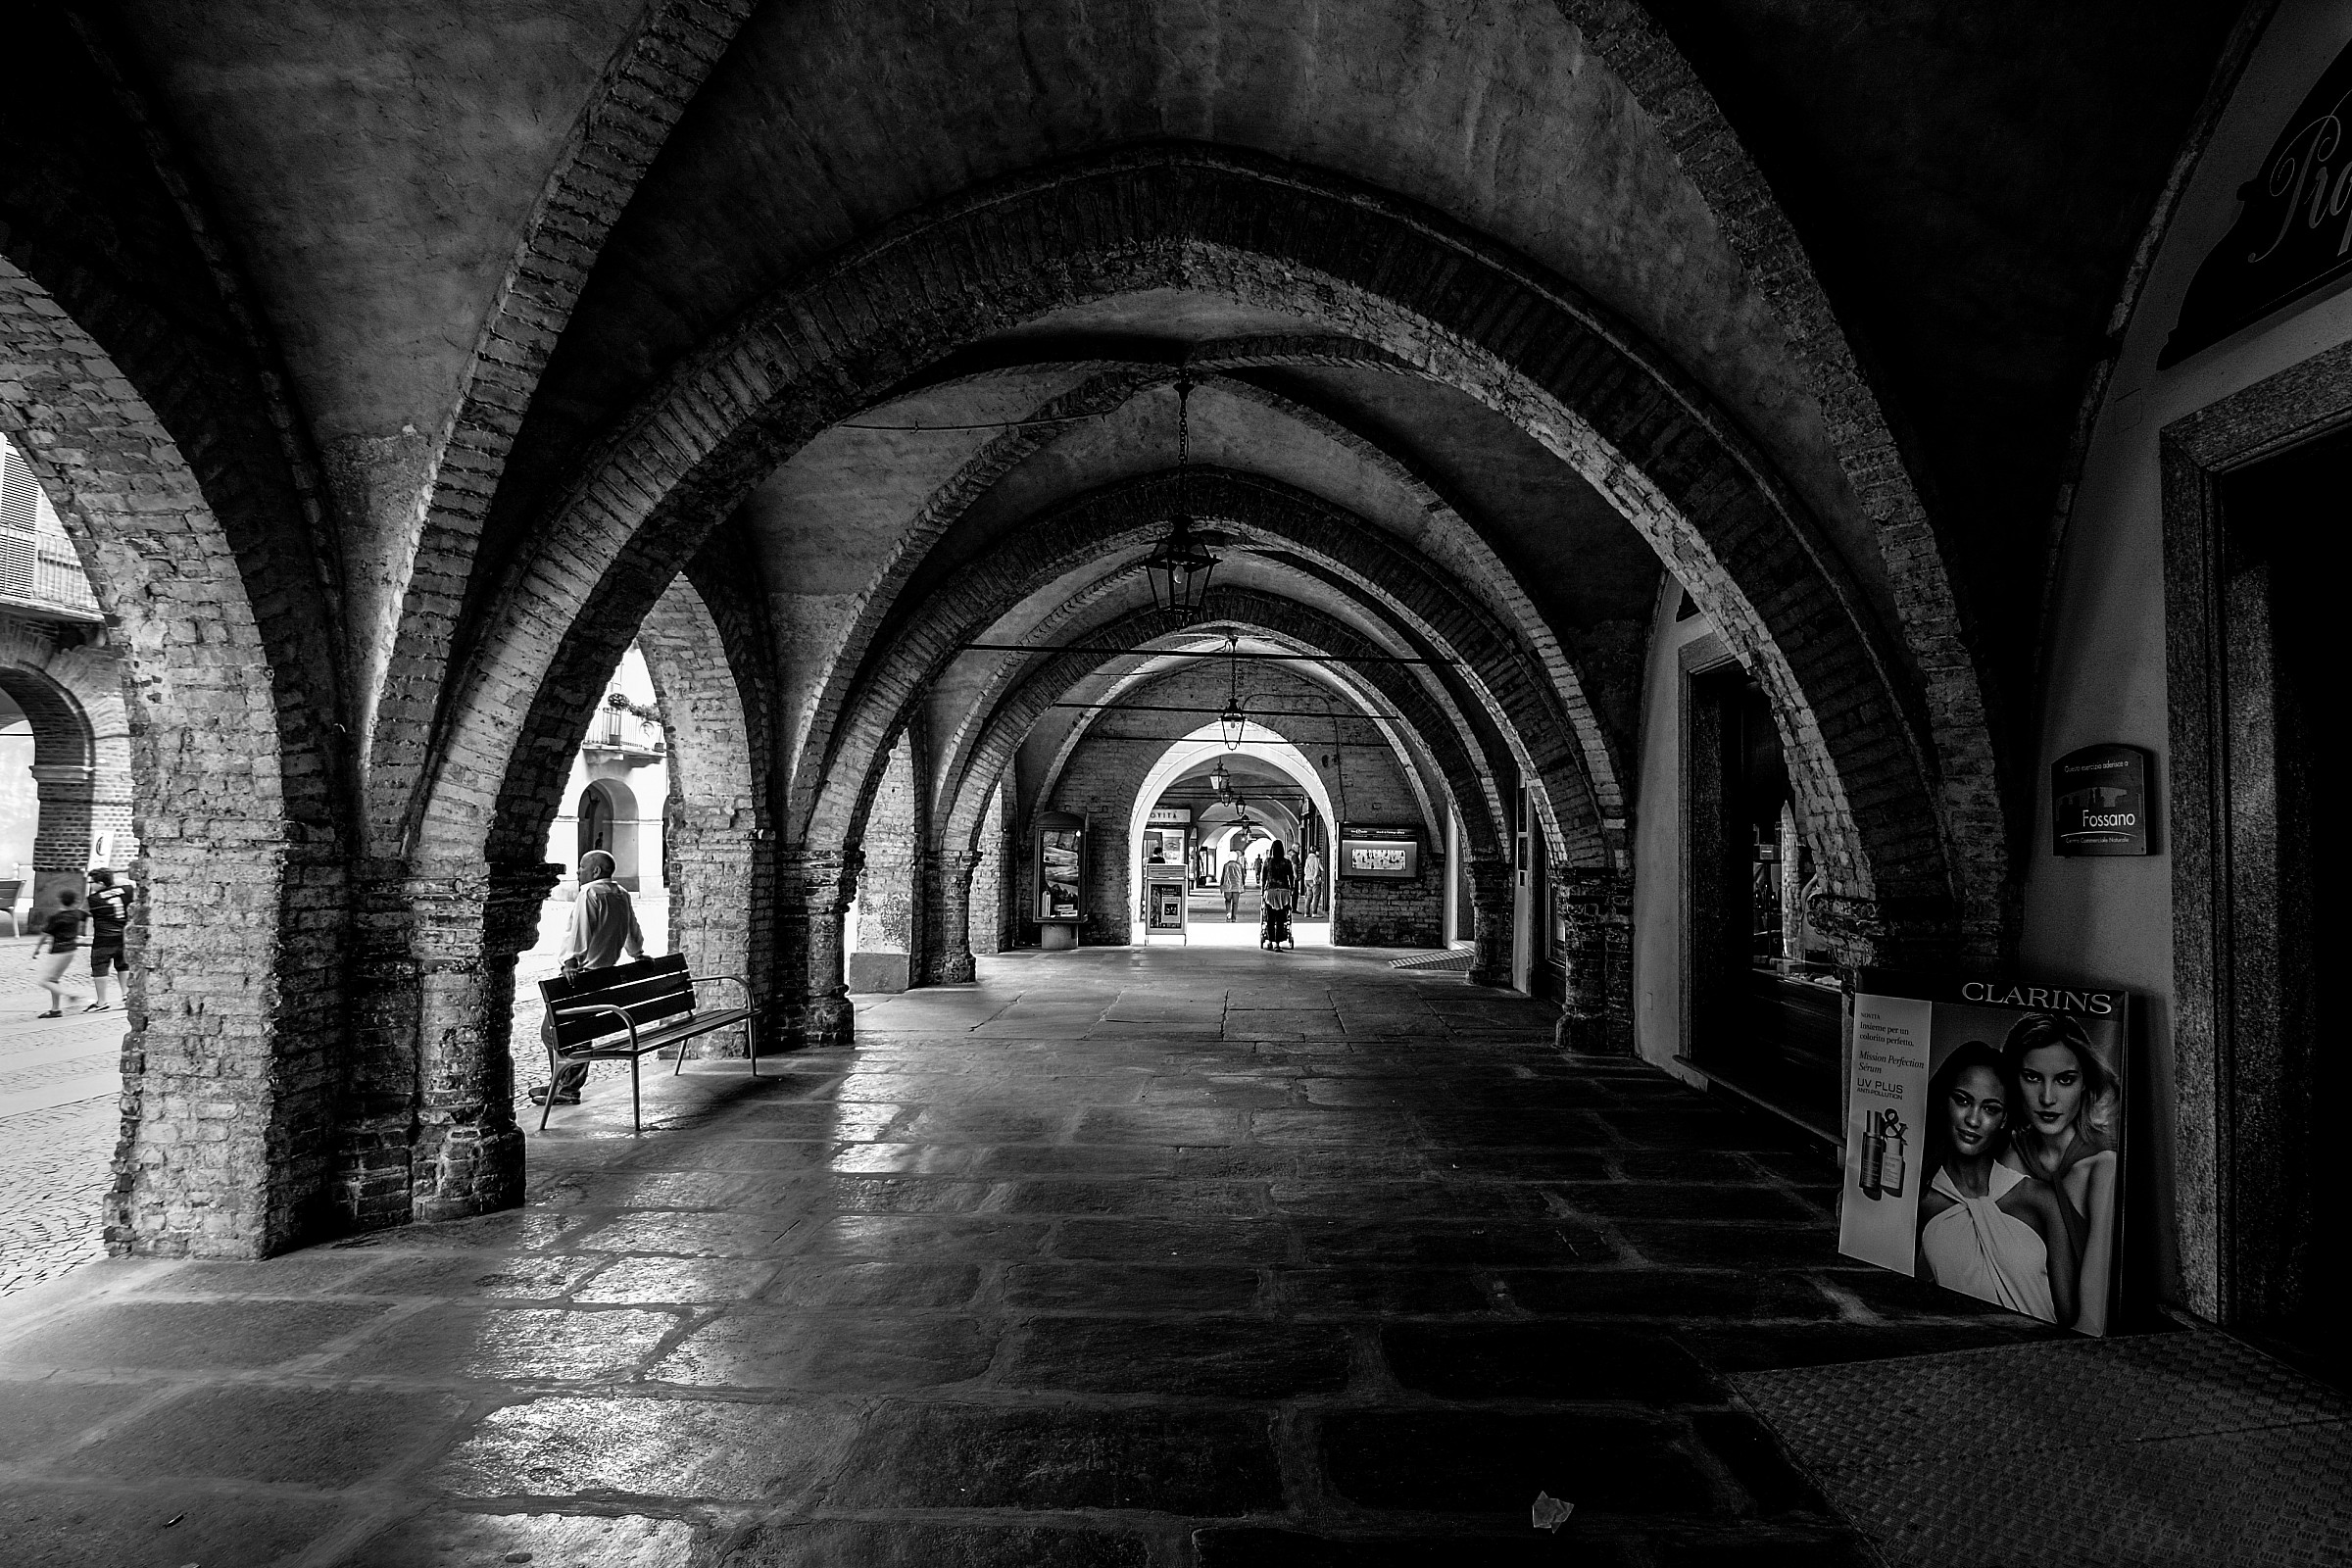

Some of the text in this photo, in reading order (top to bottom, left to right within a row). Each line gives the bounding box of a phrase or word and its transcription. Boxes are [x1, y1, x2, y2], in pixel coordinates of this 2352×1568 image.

[2248, 88, 2352, 263] Pro
[2102, 760, 2124, 769] aderisce
[2082, 809, 2135, 828] Fossano
[1962, 982, 2112, 1014] CLARINS
[1860, 1021, 1886, 1032] Insieme
[1887, 1026, 1898, 1035] per
[1859, 1033, 1914, 1047] colorito perfetto.
[1858, 1061, 1882, 1074] Sérum
[1859, 1051, 1924, 1069] Mission Perfection
[1857, 1077, 1903, 1094] UV PLUS
[1856, 1087, 1903, 1101] ANTI-POLLUTION
